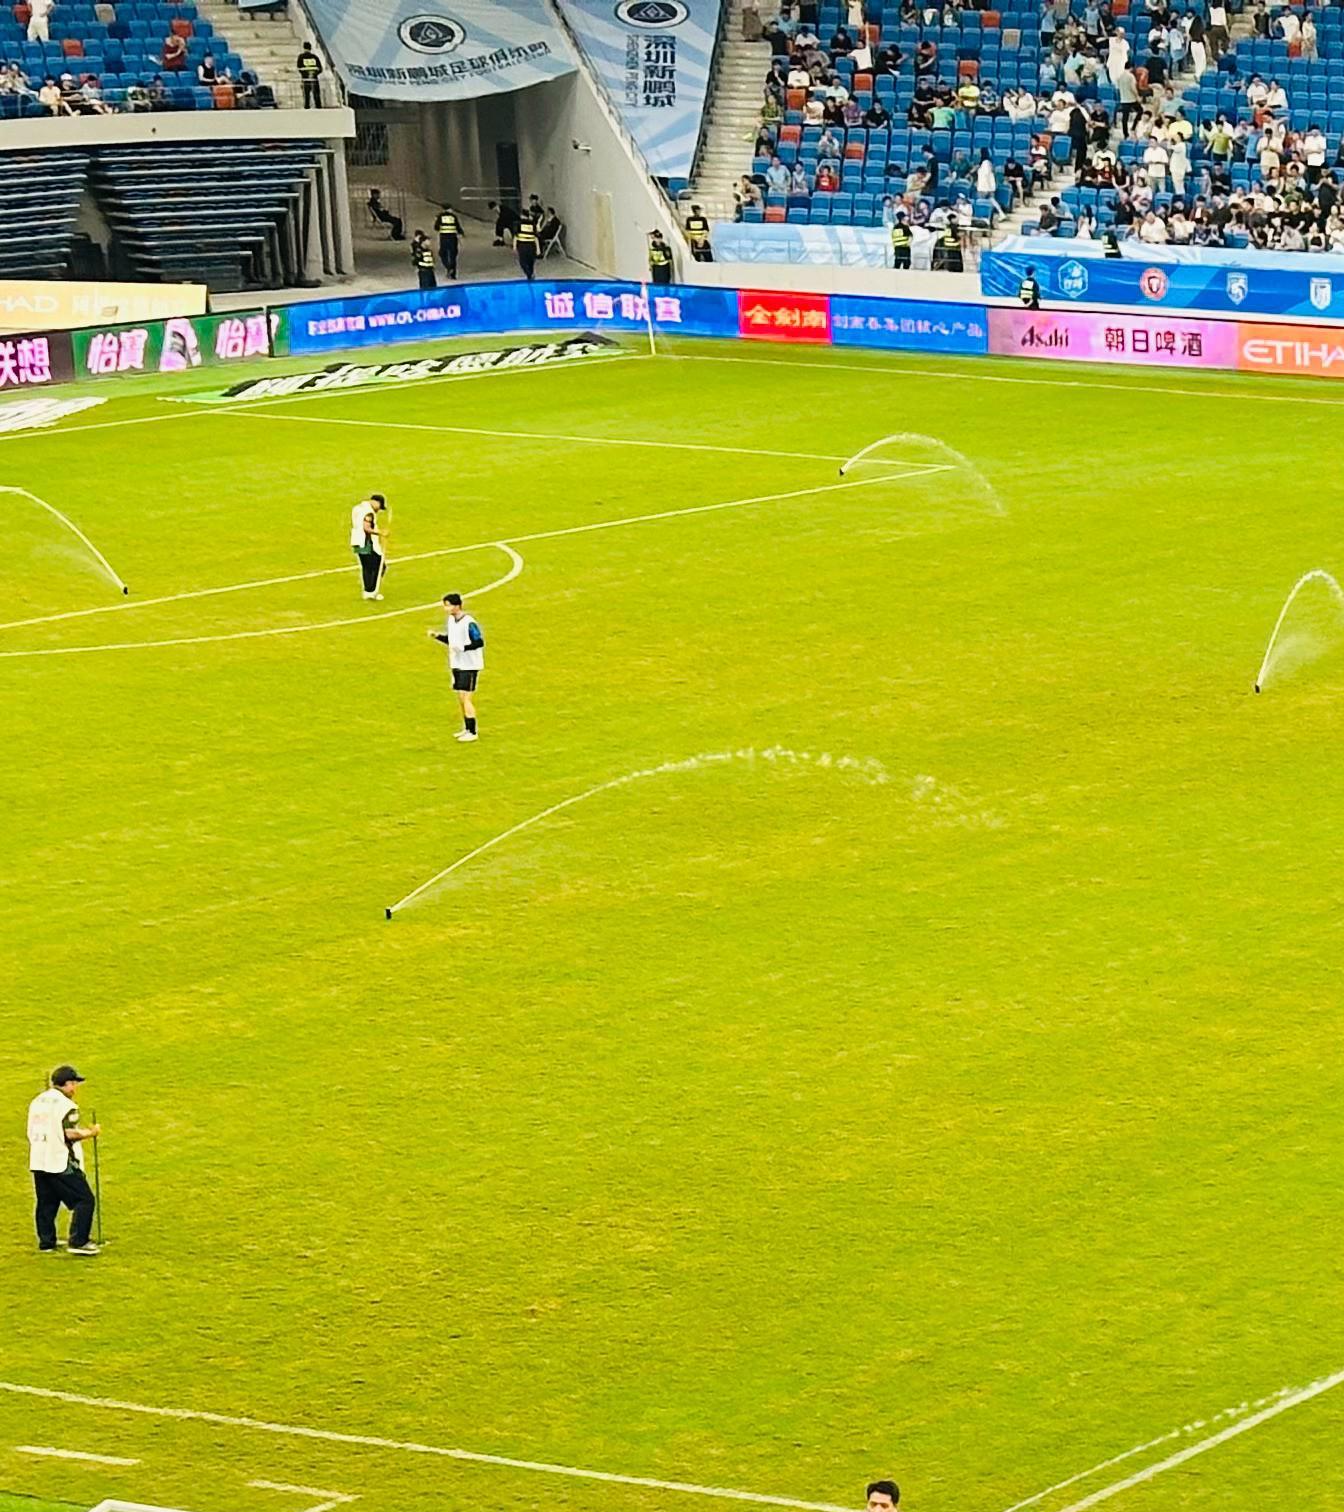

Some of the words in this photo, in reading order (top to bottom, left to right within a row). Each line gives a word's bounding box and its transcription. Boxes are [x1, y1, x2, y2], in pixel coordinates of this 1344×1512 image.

[643, 35, 677, 108] 深圳新鹏城
[544, 291, 682, 323] 诚信联赛
[1020, 325, 1070, 349] Asahi
[1104, 326, 1203, 358] 朝日啤酒
